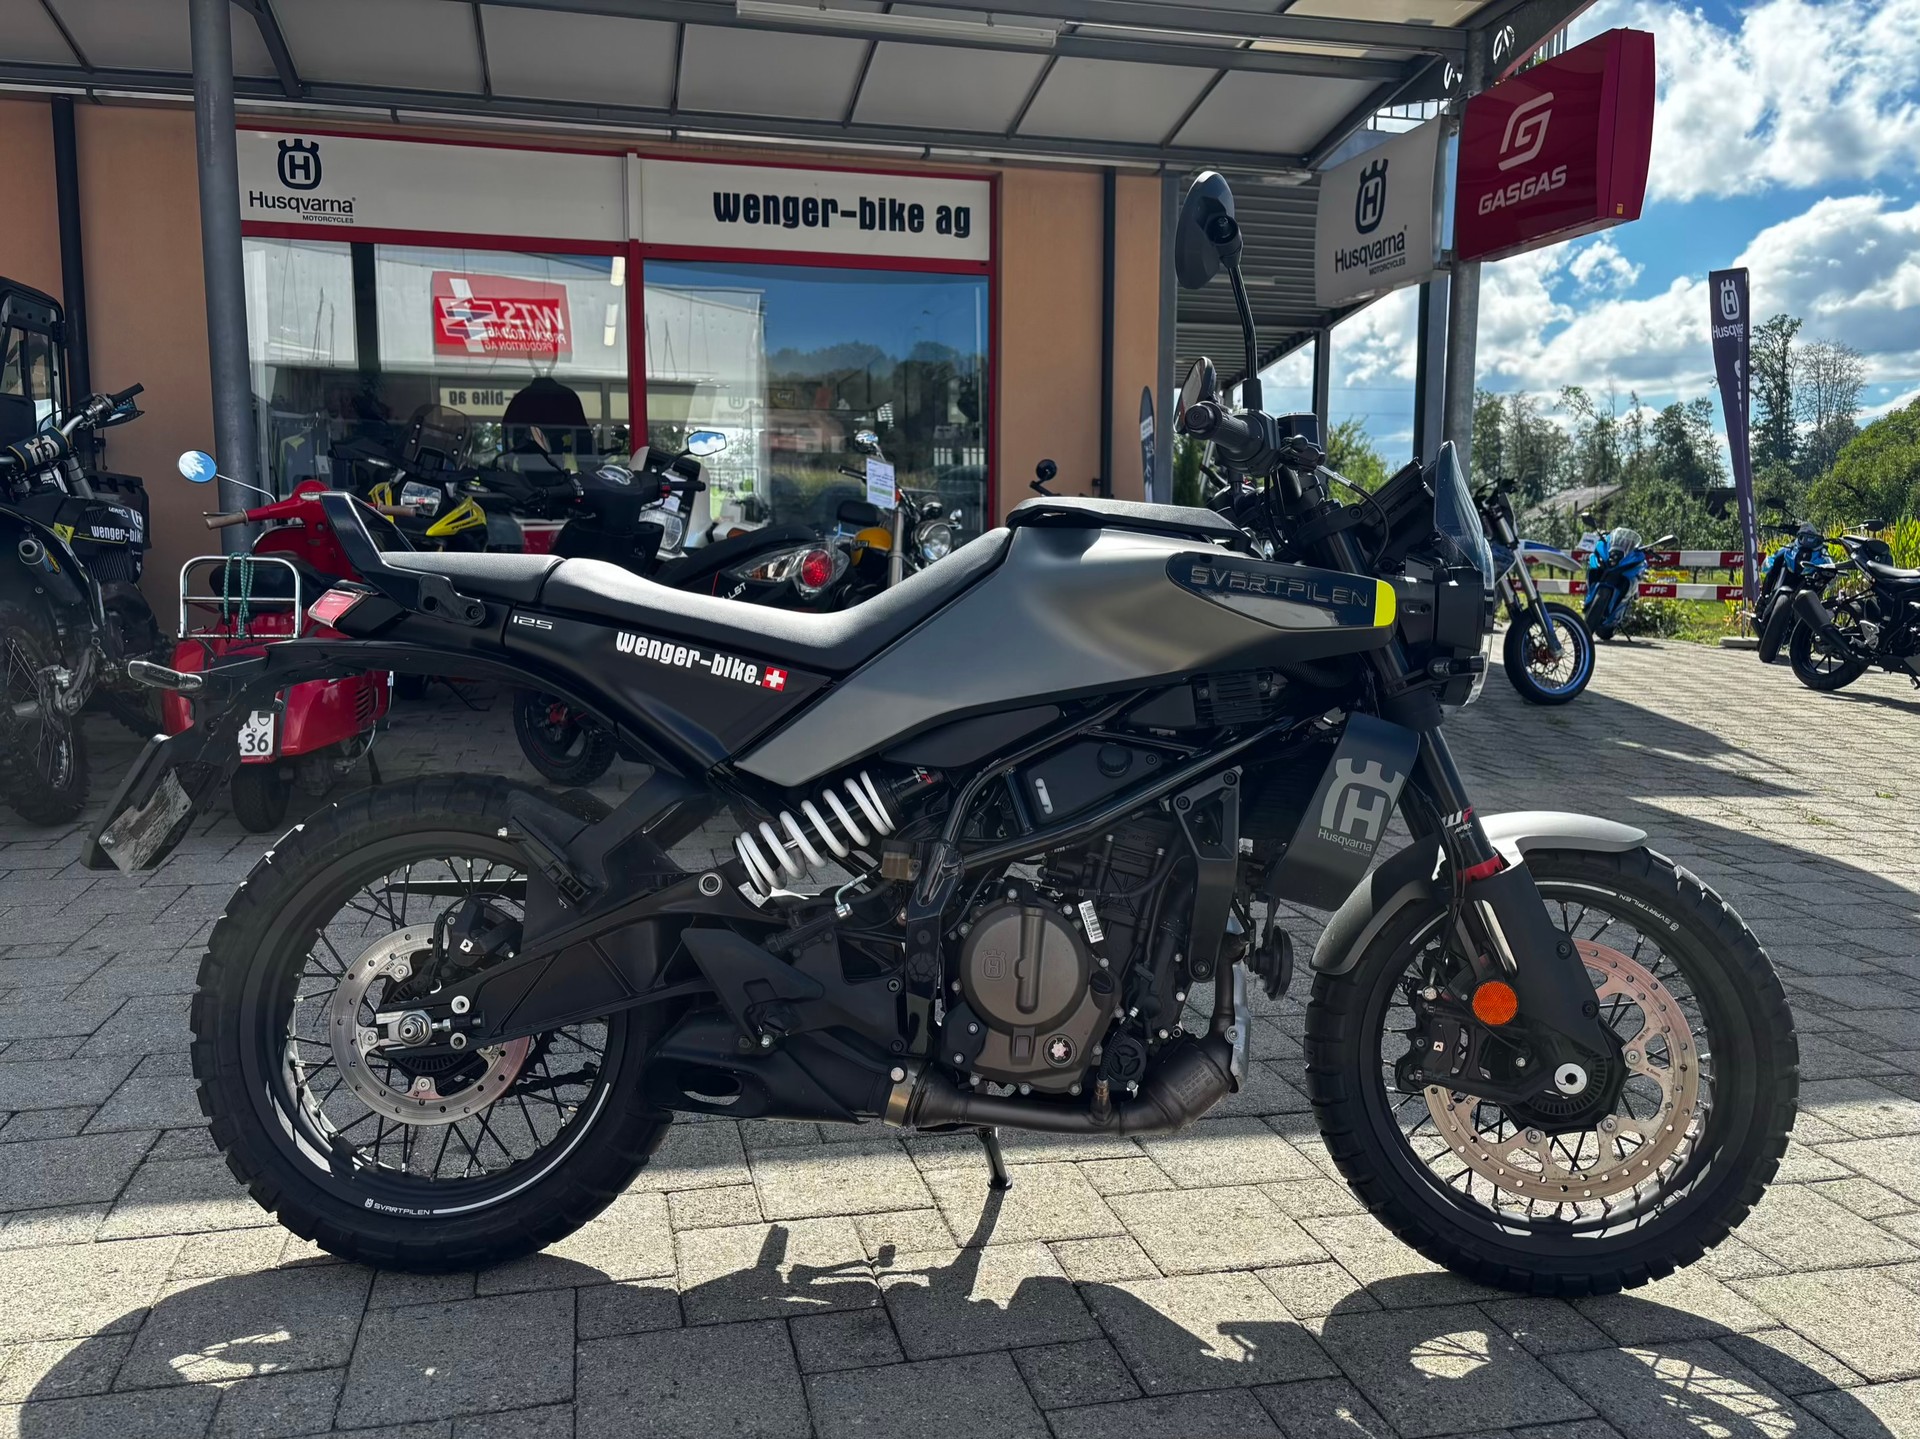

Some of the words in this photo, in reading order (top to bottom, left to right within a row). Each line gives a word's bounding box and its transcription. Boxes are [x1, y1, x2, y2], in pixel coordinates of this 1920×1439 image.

[1478, 164, 1567, 216] GASGAS
[249, 191, 353, 213] Husqvarna
[302, 215, 354, 224] MOTORCYCLES
[713, 191, 925, 233] wenger-bike
[936, 205, 971, 238] ag
[1335, 230, 1405, 273] Husqvarna
[1369, 256, 1406, 276] MOTORCYCLES
[1190, 564, 1370, 607] SVARTPILEN
[1645, 586, 1668, 594] JPF
[513, 615, 553, 630] 125
[240, 732, 269, 753] 36
[1318, 828, 1373, 851] Husqvarna
[1619, 894, 1671, 925] SVARTPILEN
[373, 1203, 430, 1215] SVARTPILEN
